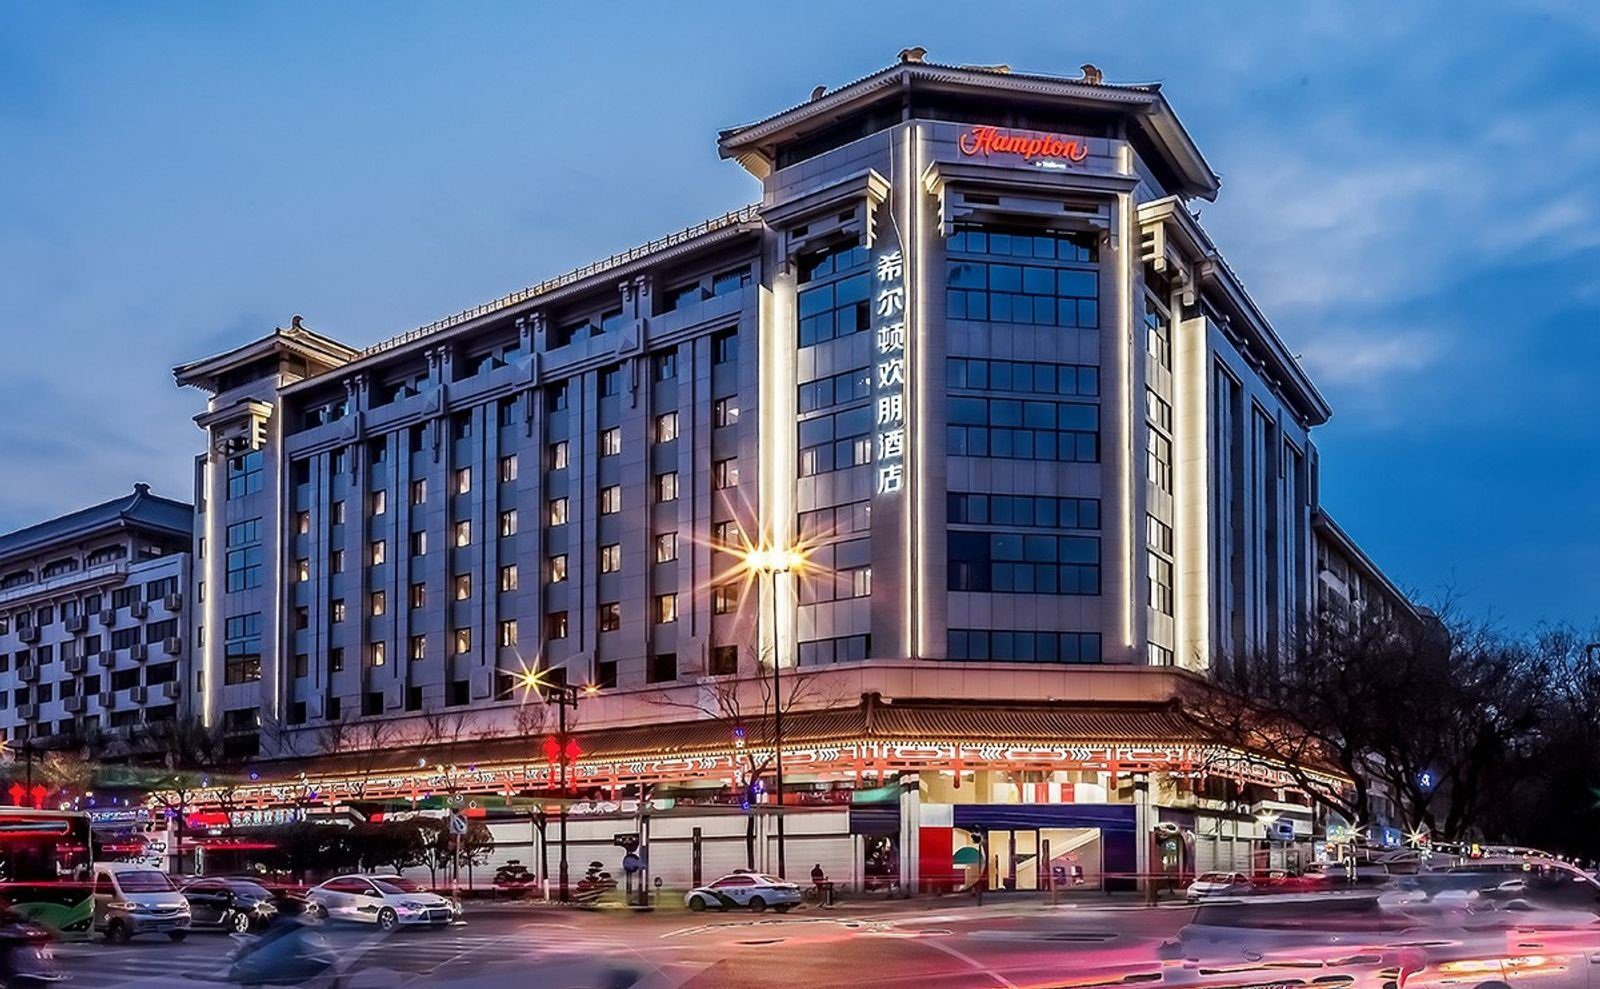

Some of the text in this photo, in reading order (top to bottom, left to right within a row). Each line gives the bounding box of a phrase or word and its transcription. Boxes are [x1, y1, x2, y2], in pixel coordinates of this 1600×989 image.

[959, 124, 1087, 161] Hampton
[877, 250, 904, 495] 希尔顿欢朋酒店
